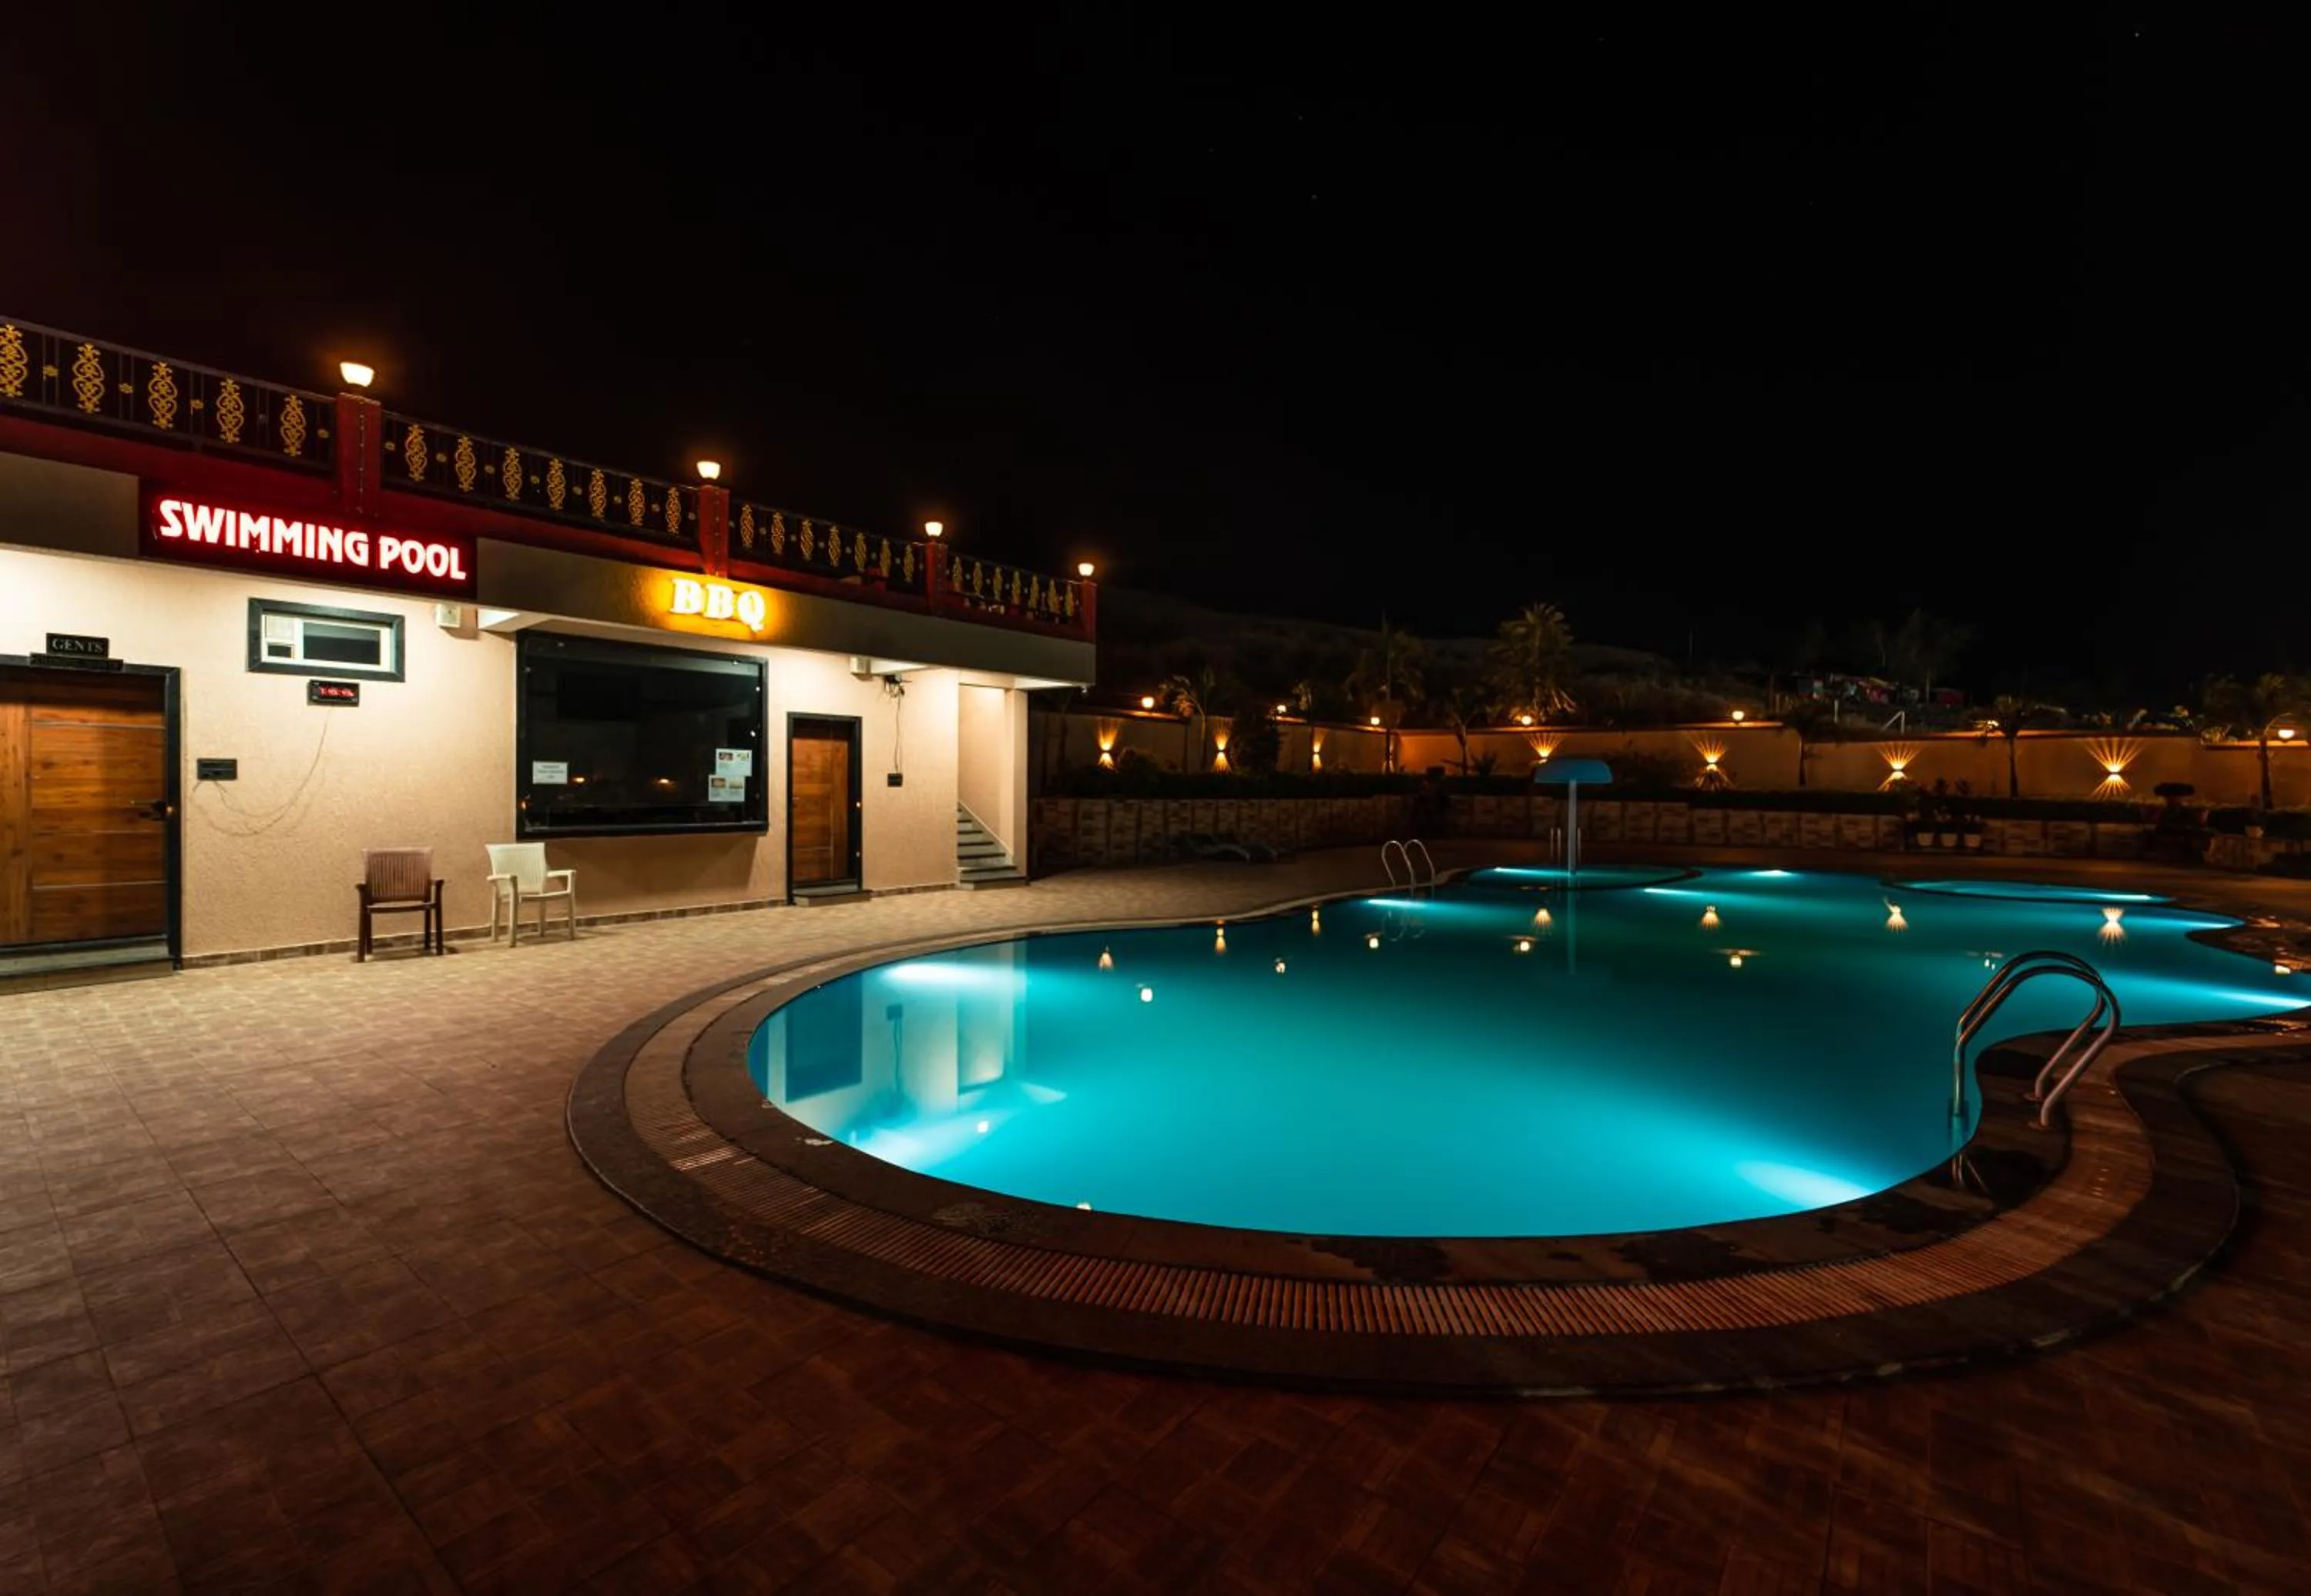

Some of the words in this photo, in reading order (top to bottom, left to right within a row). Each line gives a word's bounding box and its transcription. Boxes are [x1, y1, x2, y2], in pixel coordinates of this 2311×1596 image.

[159, 499, 369, 566] SWIMMING
[379, 535, 467, 580] POOL
[669, 578, 765, 632] BBQ
[52, 638, 104, 652] GENTS
